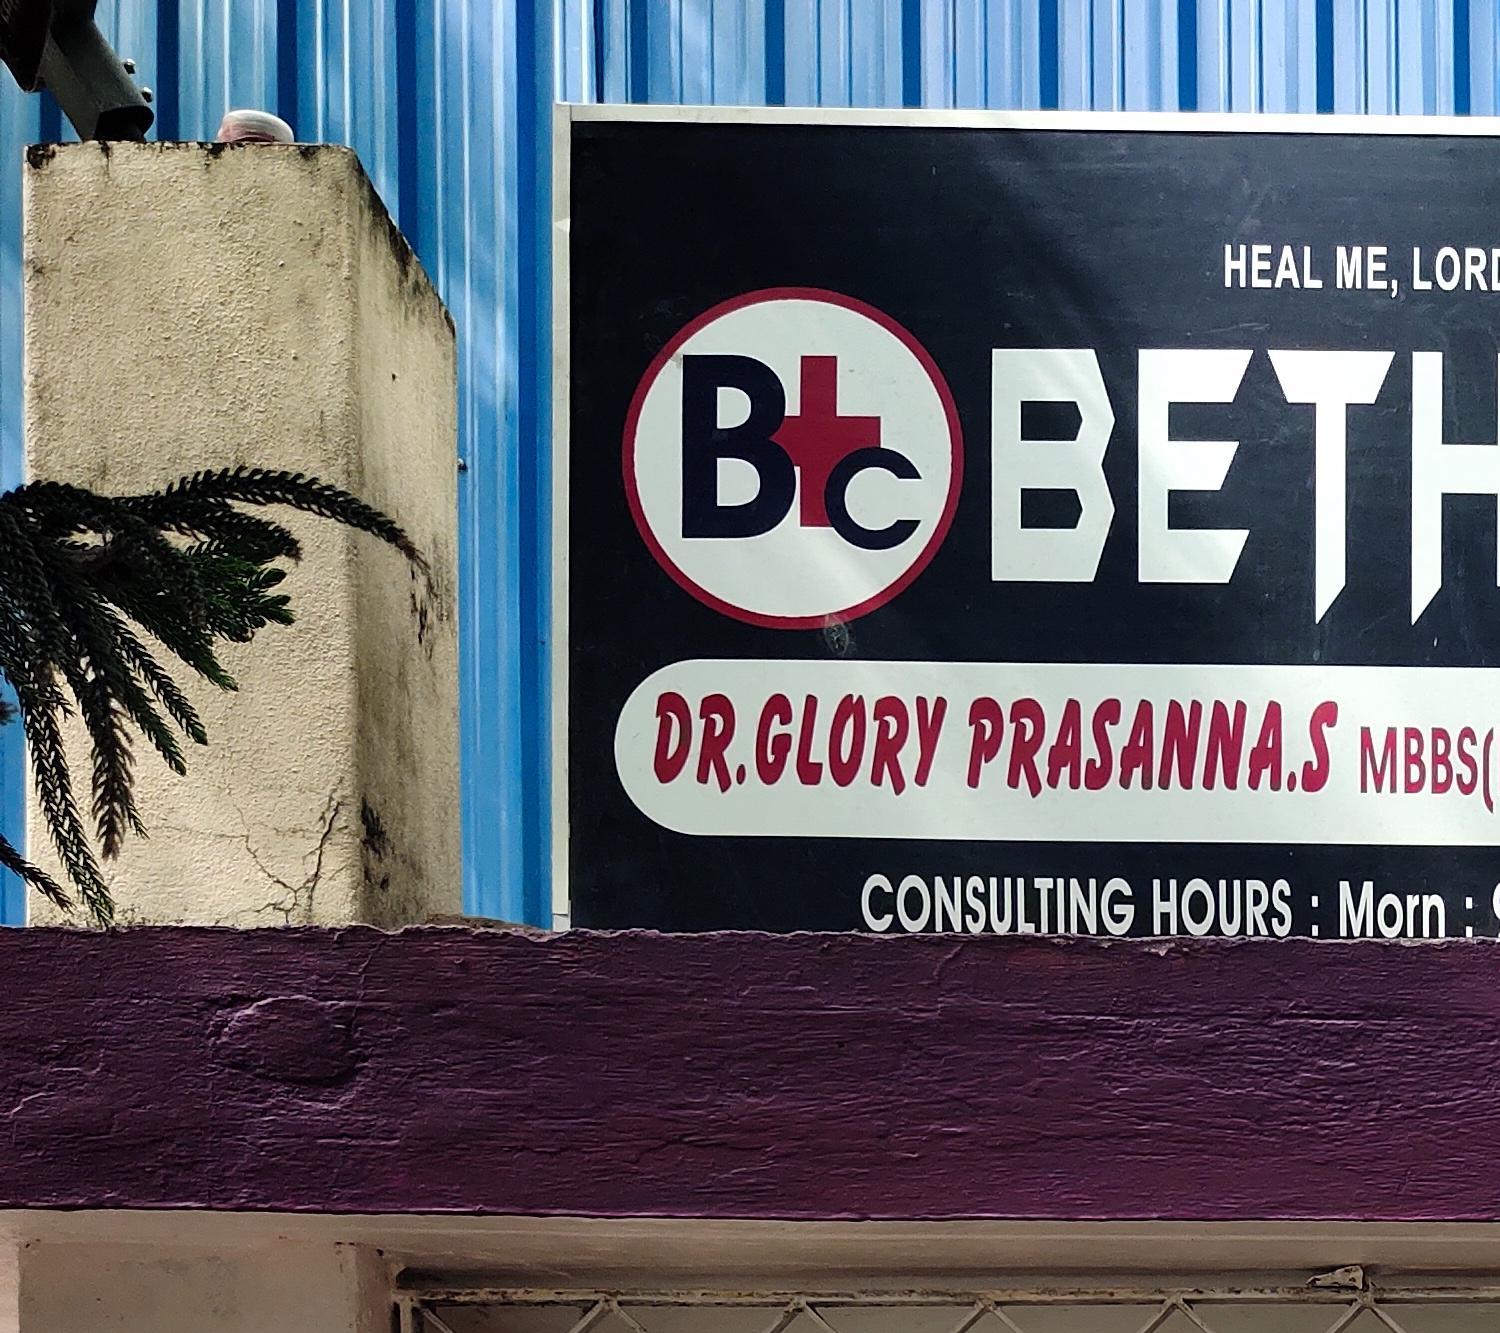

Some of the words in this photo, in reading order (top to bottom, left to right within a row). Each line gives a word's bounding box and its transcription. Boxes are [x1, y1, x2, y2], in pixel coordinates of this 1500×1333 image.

[1224, 243, 1323, 289] HEAL
[1336, 245, 1398, 299] ME,
[653, 691, 948, 795] DR.GLORY
[966, 696, 1339, 799] PRASANNA.S
[860, 873, 1135, 936] CONSULTING
[1152, 878, 1292, 938] HOURS
[1339, 880, 1446, 939] Morn
